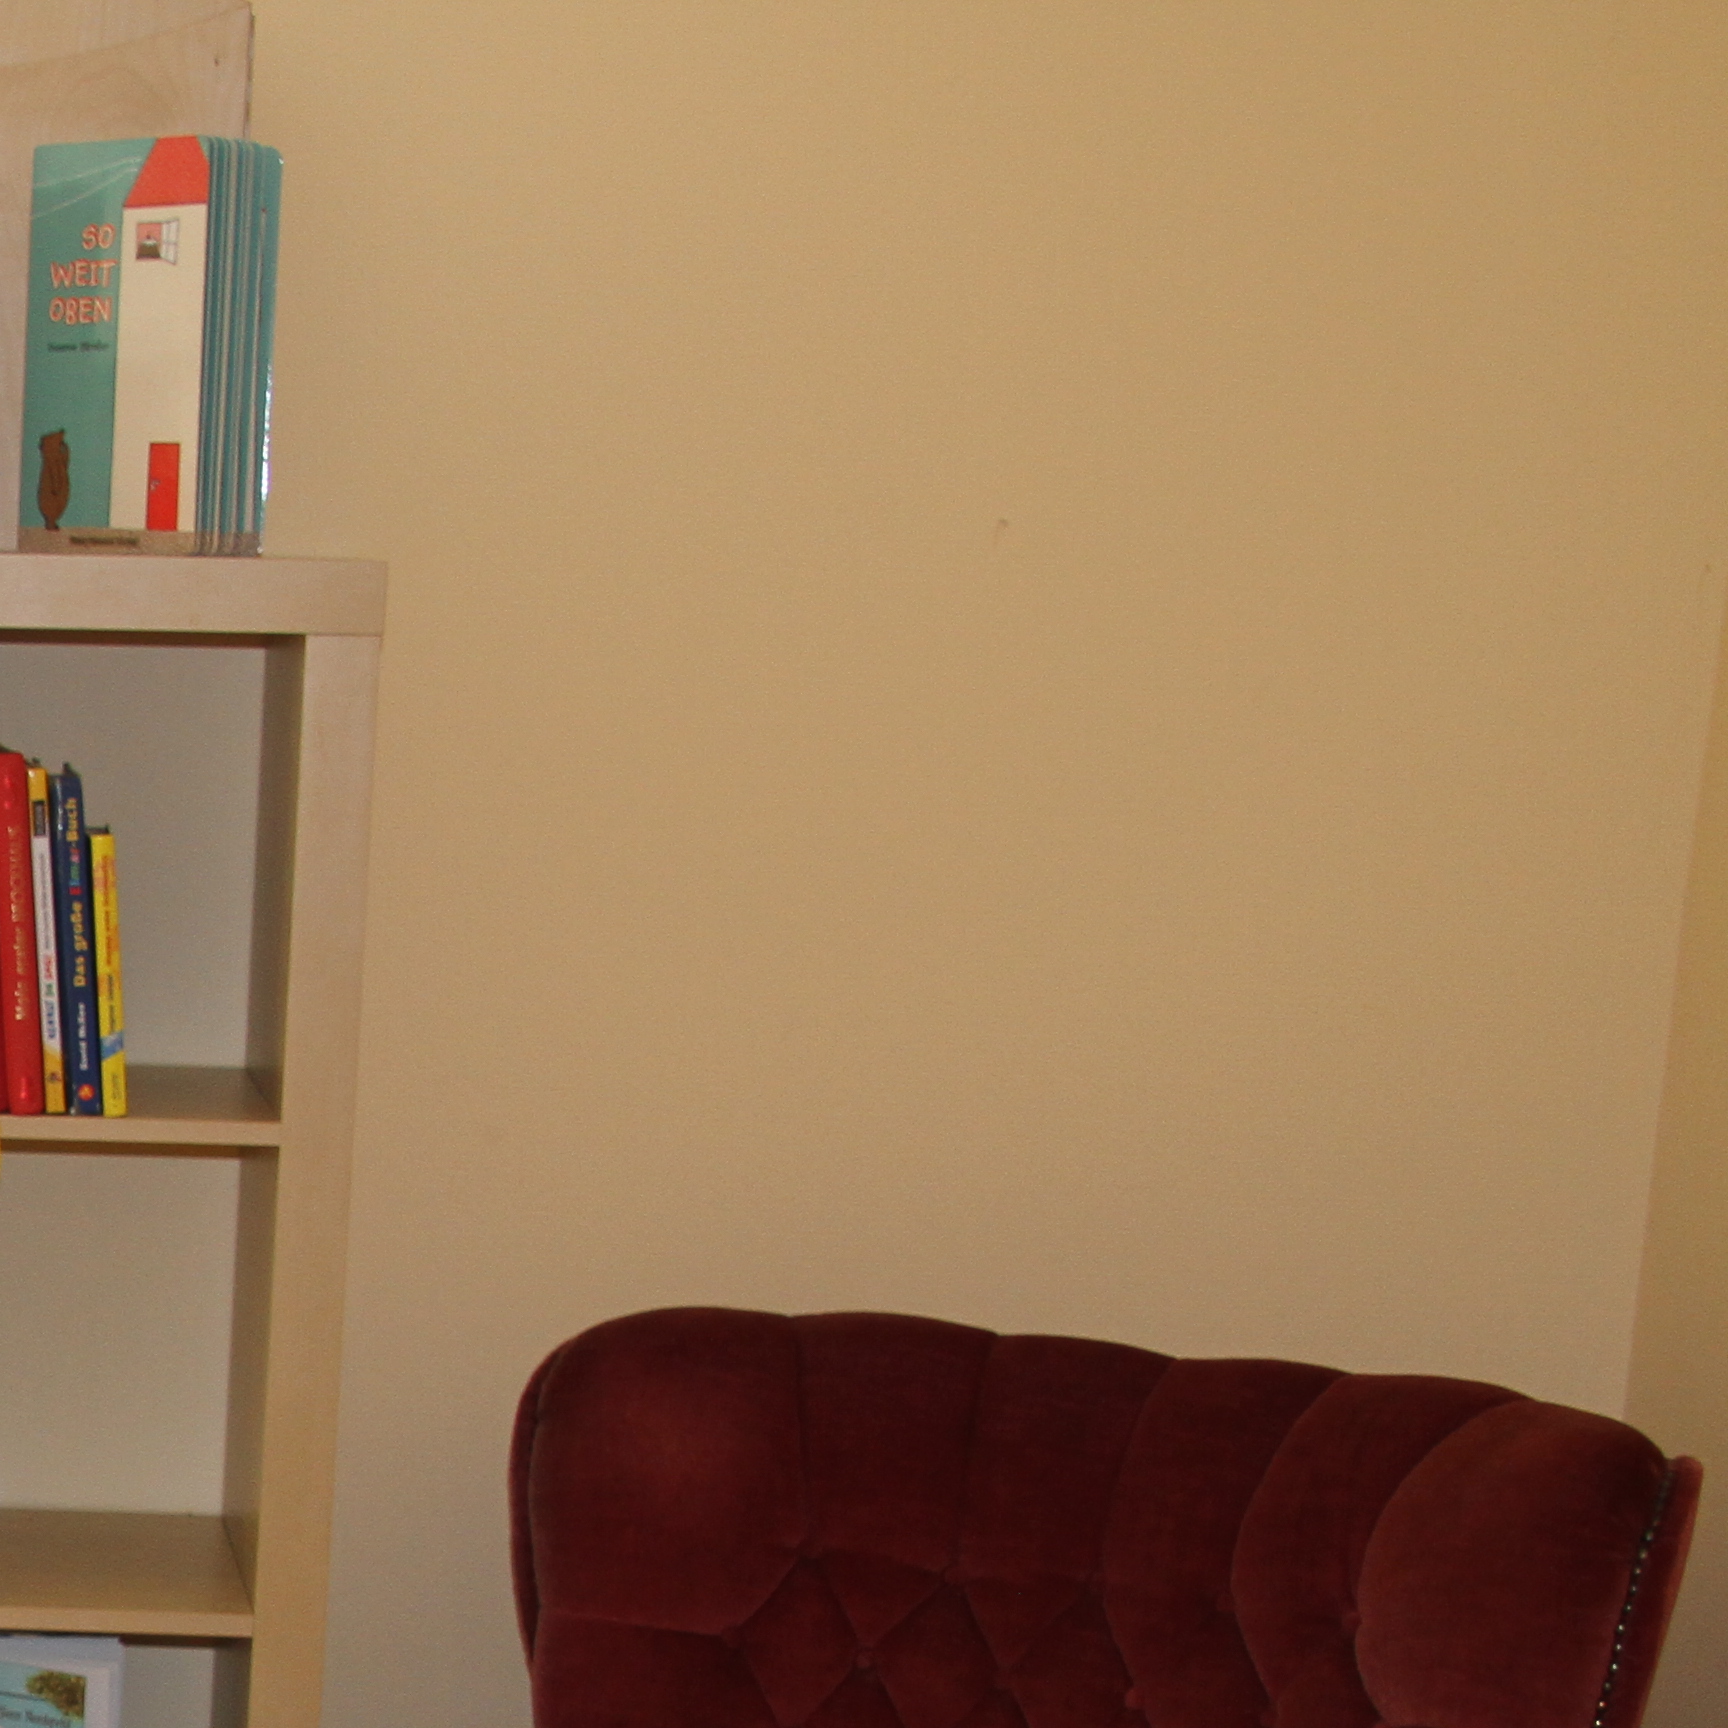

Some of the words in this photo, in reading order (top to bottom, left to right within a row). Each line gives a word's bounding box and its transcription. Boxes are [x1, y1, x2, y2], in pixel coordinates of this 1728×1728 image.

[82, 223, 116, 250] SO
[50, 258, 118, 289] WEIT
[49, 296, 113, 325] OBEN
[70, 901, 88, 951] große
[73, 954, 87, 988] Das
